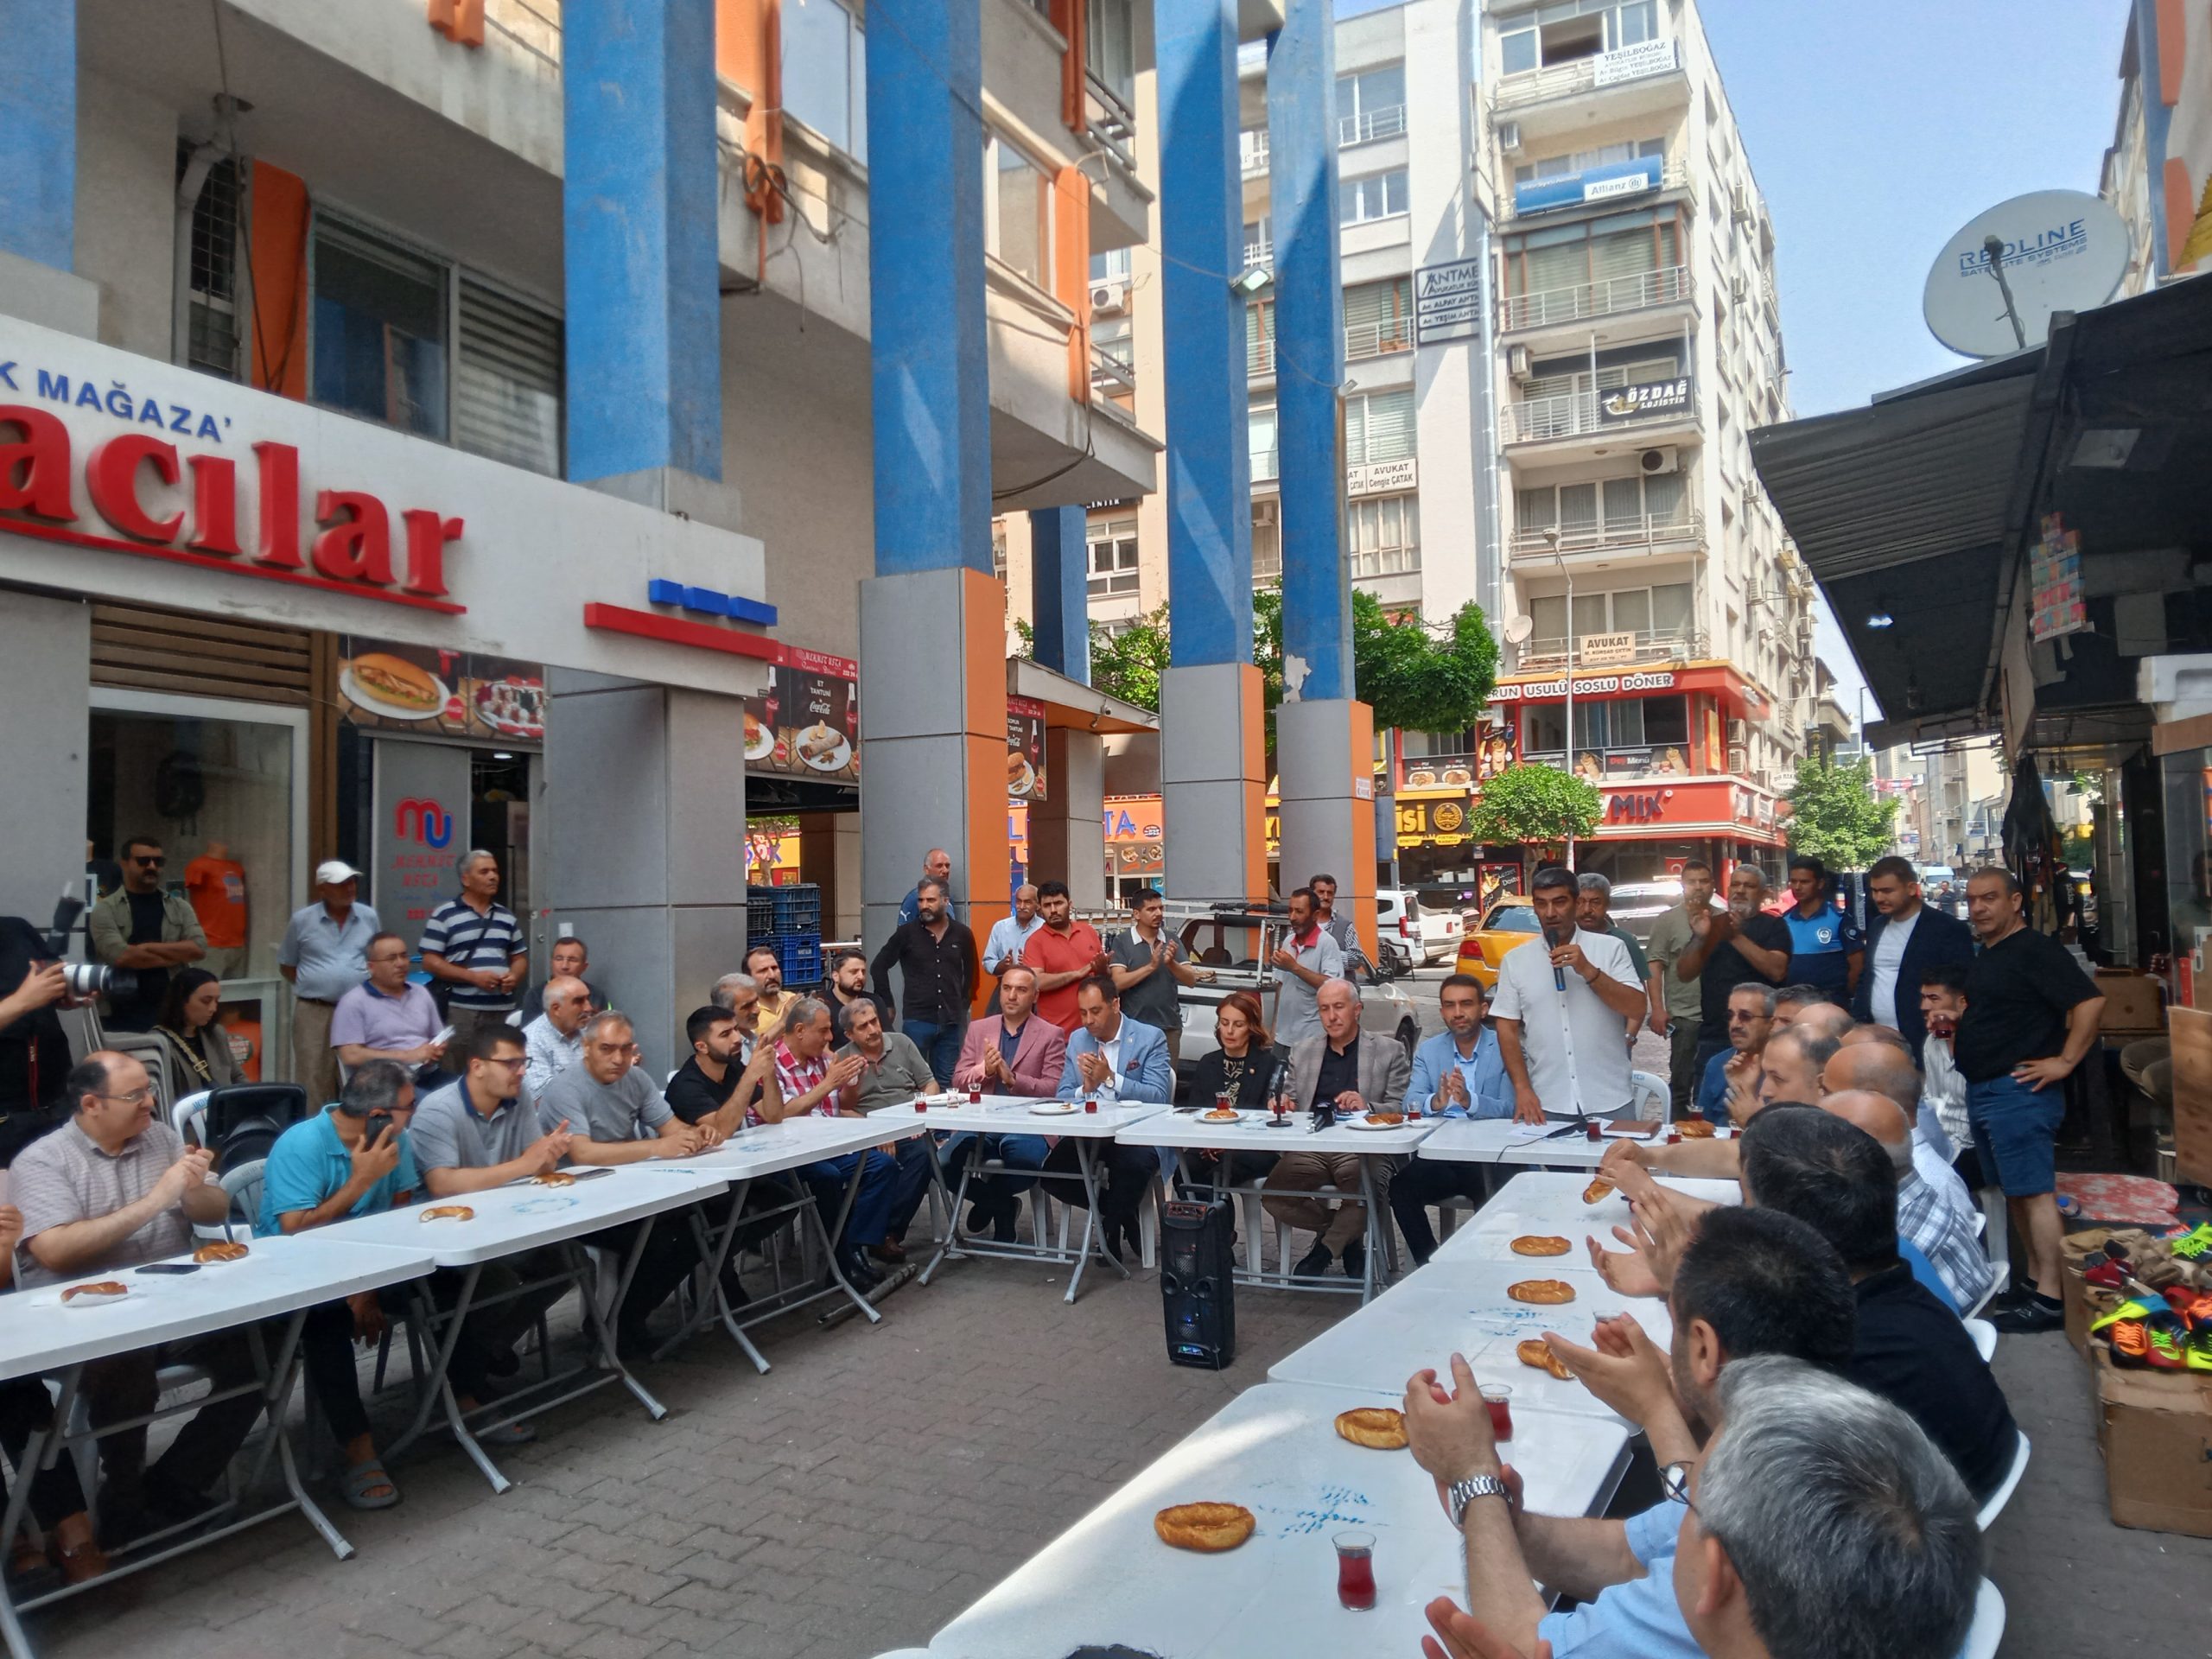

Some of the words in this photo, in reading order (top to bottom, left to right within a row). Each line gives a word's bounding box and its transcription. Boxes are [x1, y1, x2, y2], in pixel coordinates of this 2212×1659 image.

[1605, 42, 1666, 61] YEŞİLBOĞAZ
[1591, 181, 1626, 196] Allianz
[2028, 238, 2088, 263] SYSTEMS
[1422, 265, 1479, 296] ANTME
[1434, 298, 1458, 308] ALPAY
[1627, 379, 1688, 404] ÖZDAĞ
[1641, 395, 1687, 409] LOJİSTİK
[1374, 463, 1409, 475] AVUKAT
[1369, 478, 1390, 488] Cengiz
[1391, 474, 1414, 486] ÇATAK
[1587, 636, 1630, 649] AVUKAT
[810, 687, 831, 697] TANTUNİ
[1488, 687, 1518, 700] RUN
[1527, 681, 1567, 696] USULÜ
[1575, 679, 1617, 692] SOSLU
[1624, 674, 1672, 689] DÖNER
